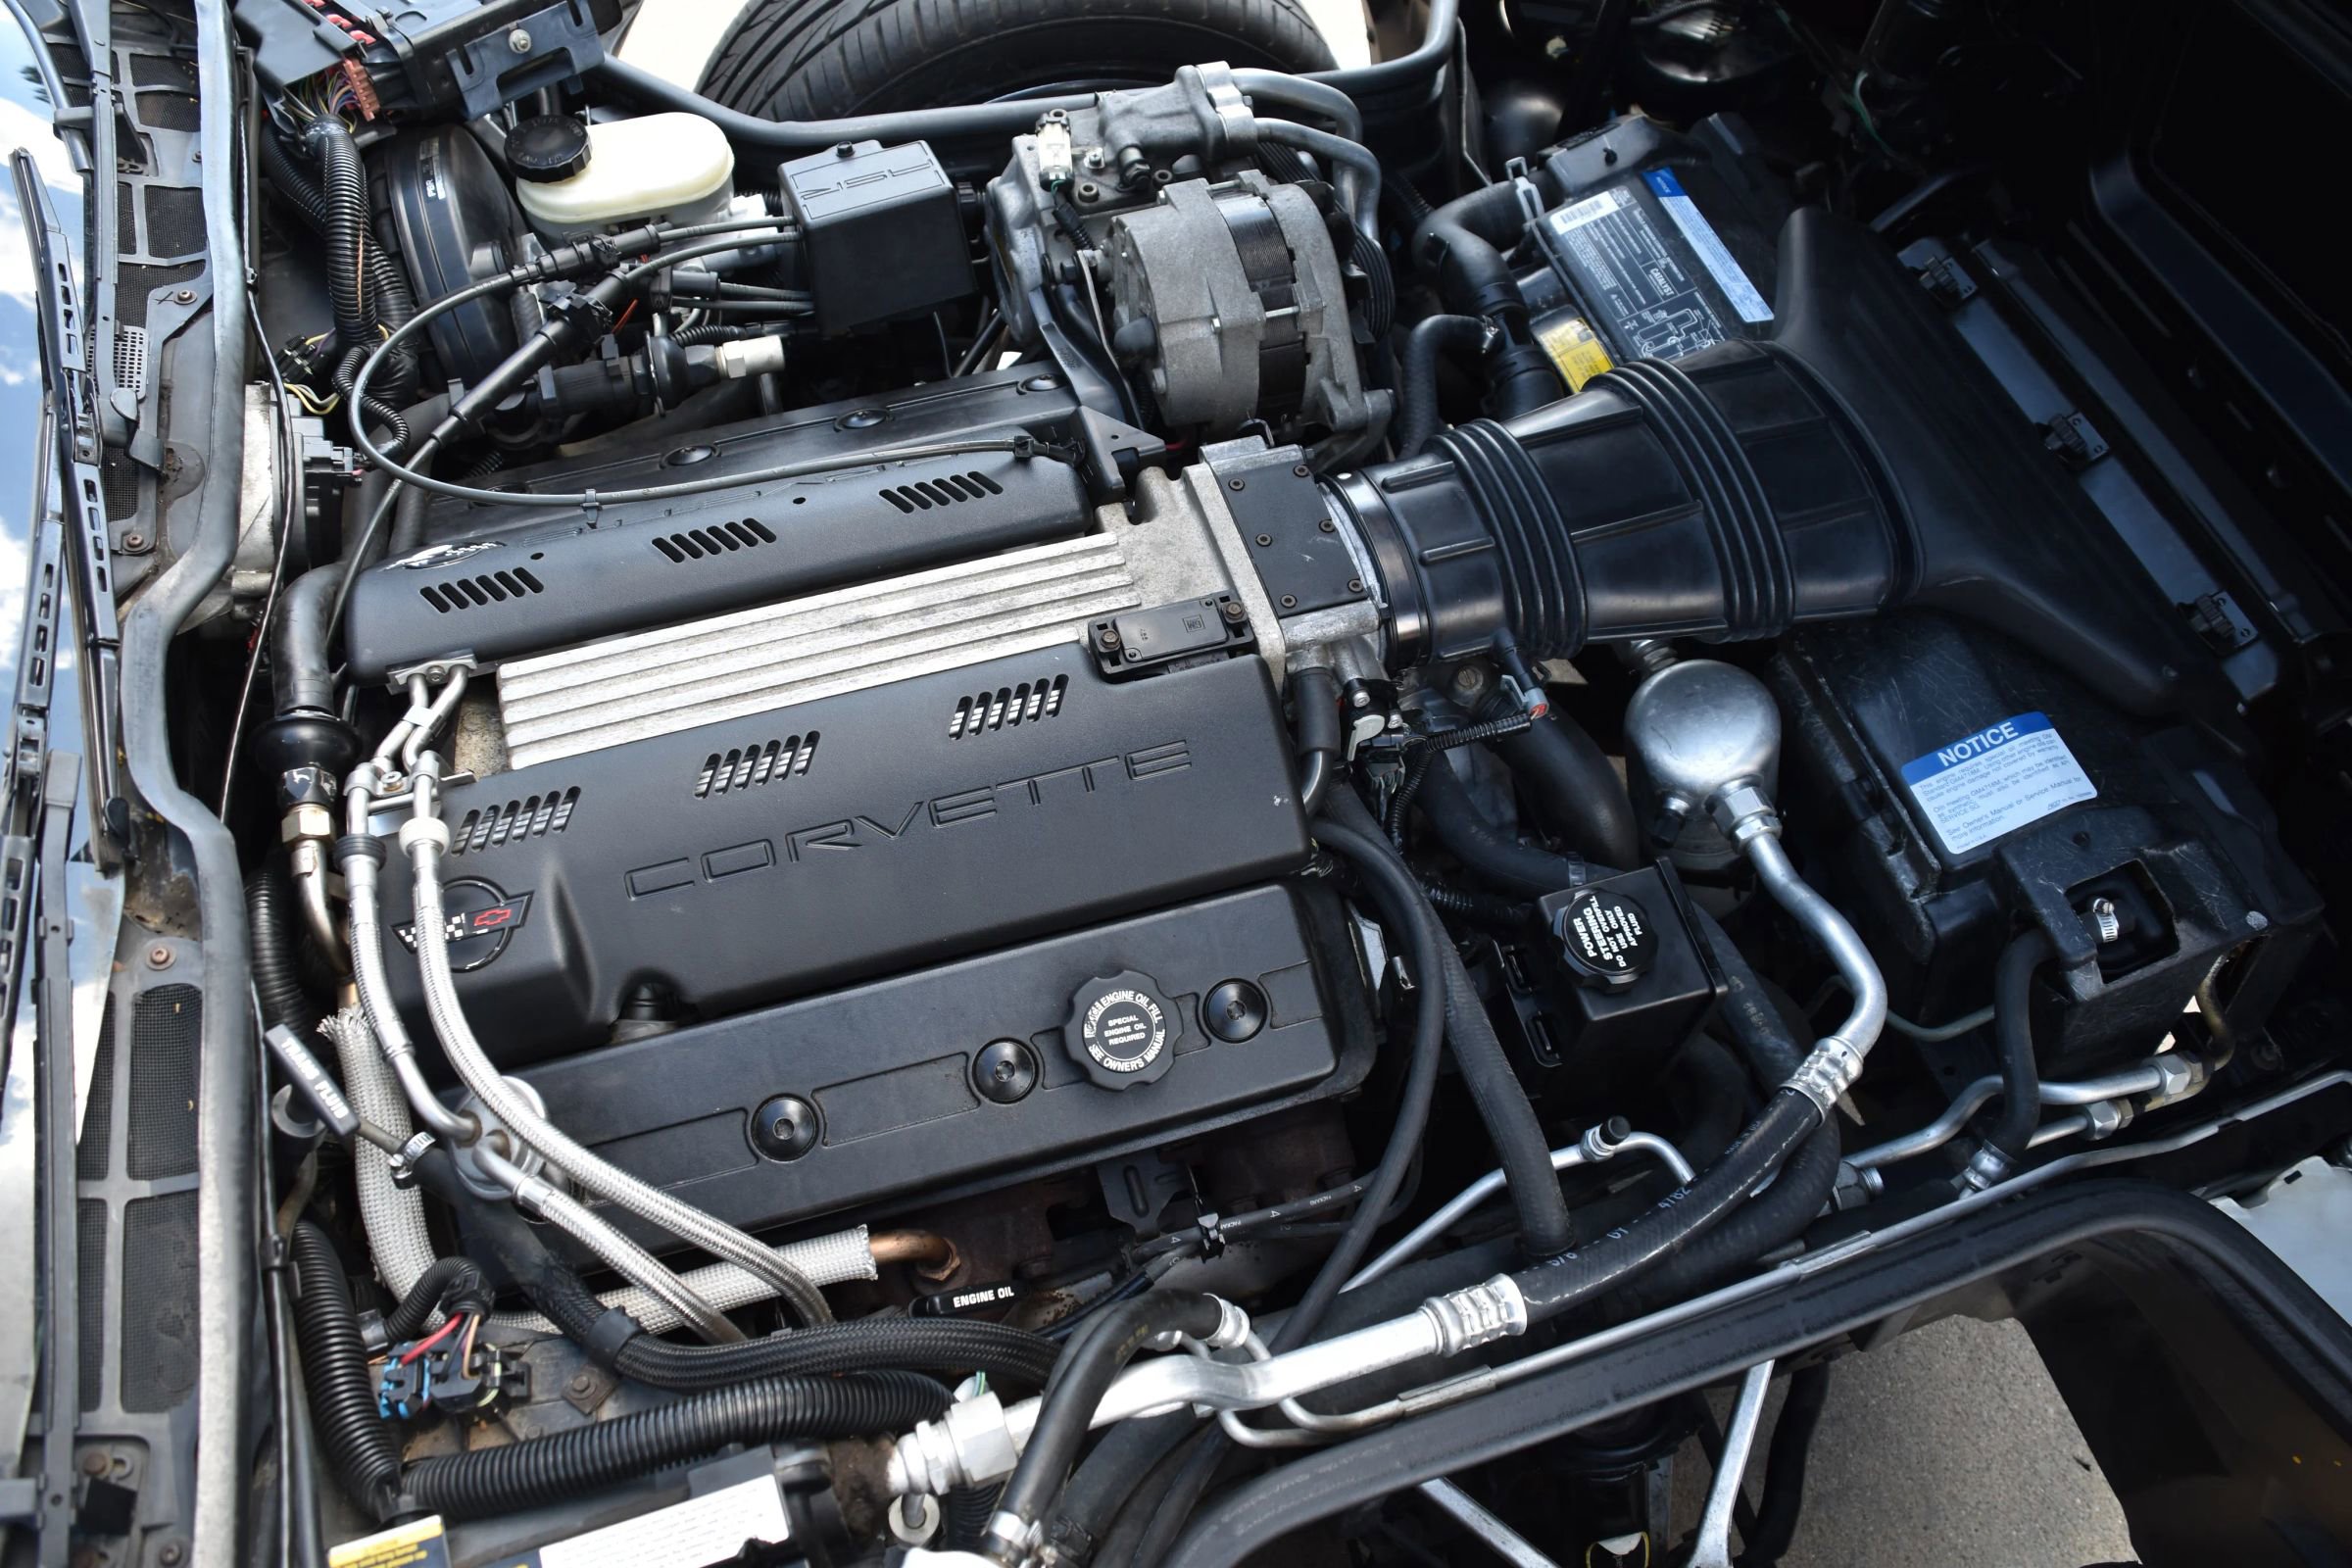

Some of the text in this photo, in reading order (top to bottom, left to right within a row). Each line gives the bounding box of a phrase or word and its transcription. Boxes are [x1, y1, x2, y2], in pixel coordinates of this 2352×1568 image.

[1648, 265, 1675, 299] CATALYST
[1937, 721, 2019, 767] NOTICE
[623, 739, 1193, 902] CORVETTE
[1573, 917, 1597, 957] POWER
[1584, 906, 1613, 960] STEERING
[1590, 896, 1627, 967] DO NOT OVERFILL
[1604, 909, 1628, 949] USE ONLY
[1614, 906, 1639, 947] APPROVED
[1627, 912, 1642, 936] FLUID
[1100, 990, 1163, 1024] ENGINE OIL FILL
[1107, 1014, 1139, 1026] SPECIAL
[1088, 1028, 1166, 1072] SEE OWNER'S MANUAL
[1104, 1025, 1132, 1038] ENGINE
[1108, 1032, 1146, 1046] REQUIRED
[281, 1037, 349, 1119] TRANS FLUID
[953, 1286, 1015, 1308] ENGINE OIL
